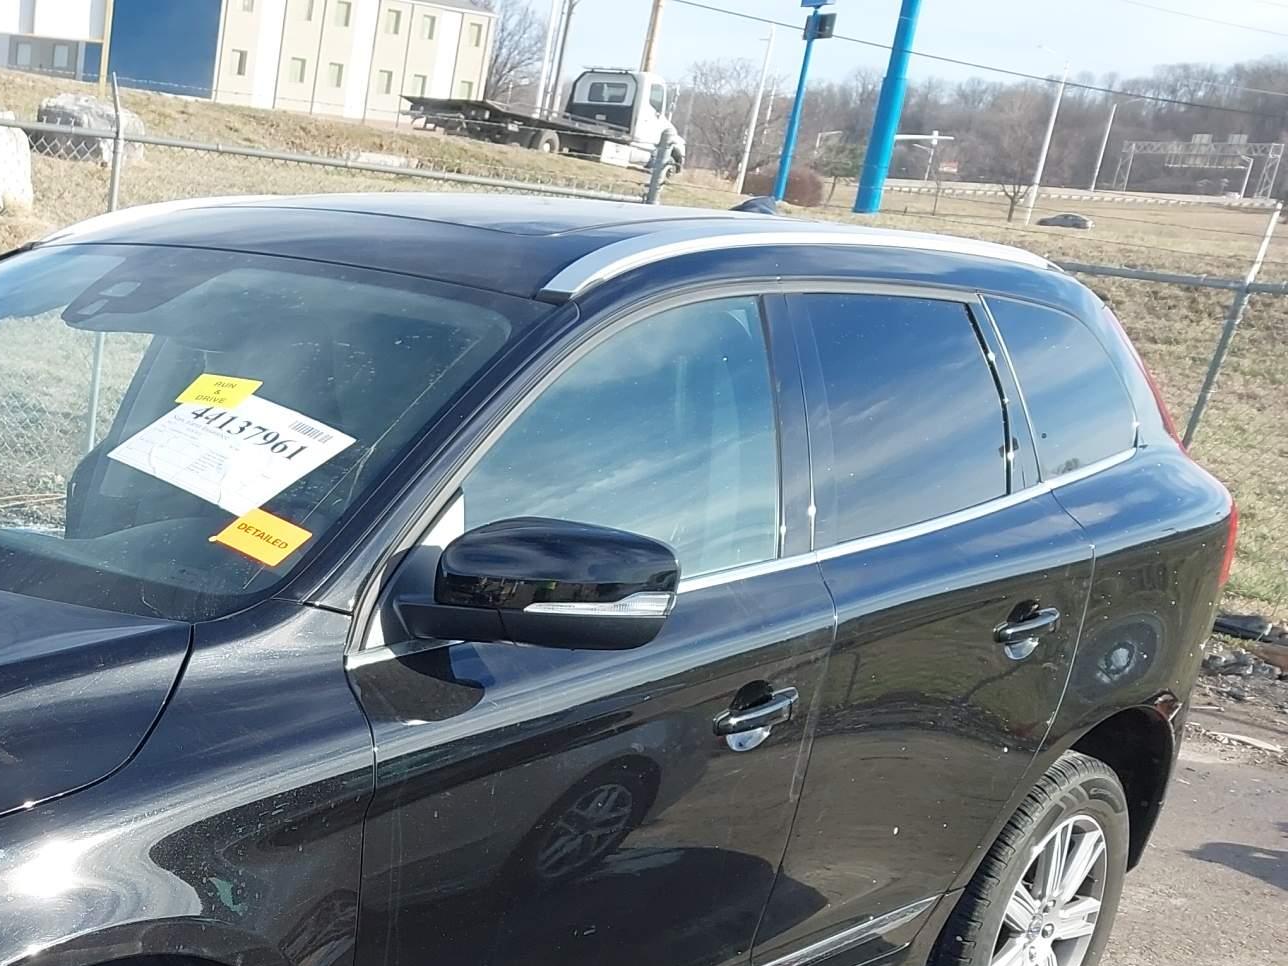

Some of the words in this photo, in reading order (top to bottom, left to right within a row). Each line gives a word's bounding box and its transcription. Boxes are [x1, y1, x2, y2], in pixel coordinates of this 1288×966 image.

[214, 381, 237, 389] RUN
[195, 394, 227, 404] DRIVE
[191, 406, 307, 460] 44137961
[237, 522, 289, 549] DETAILED
